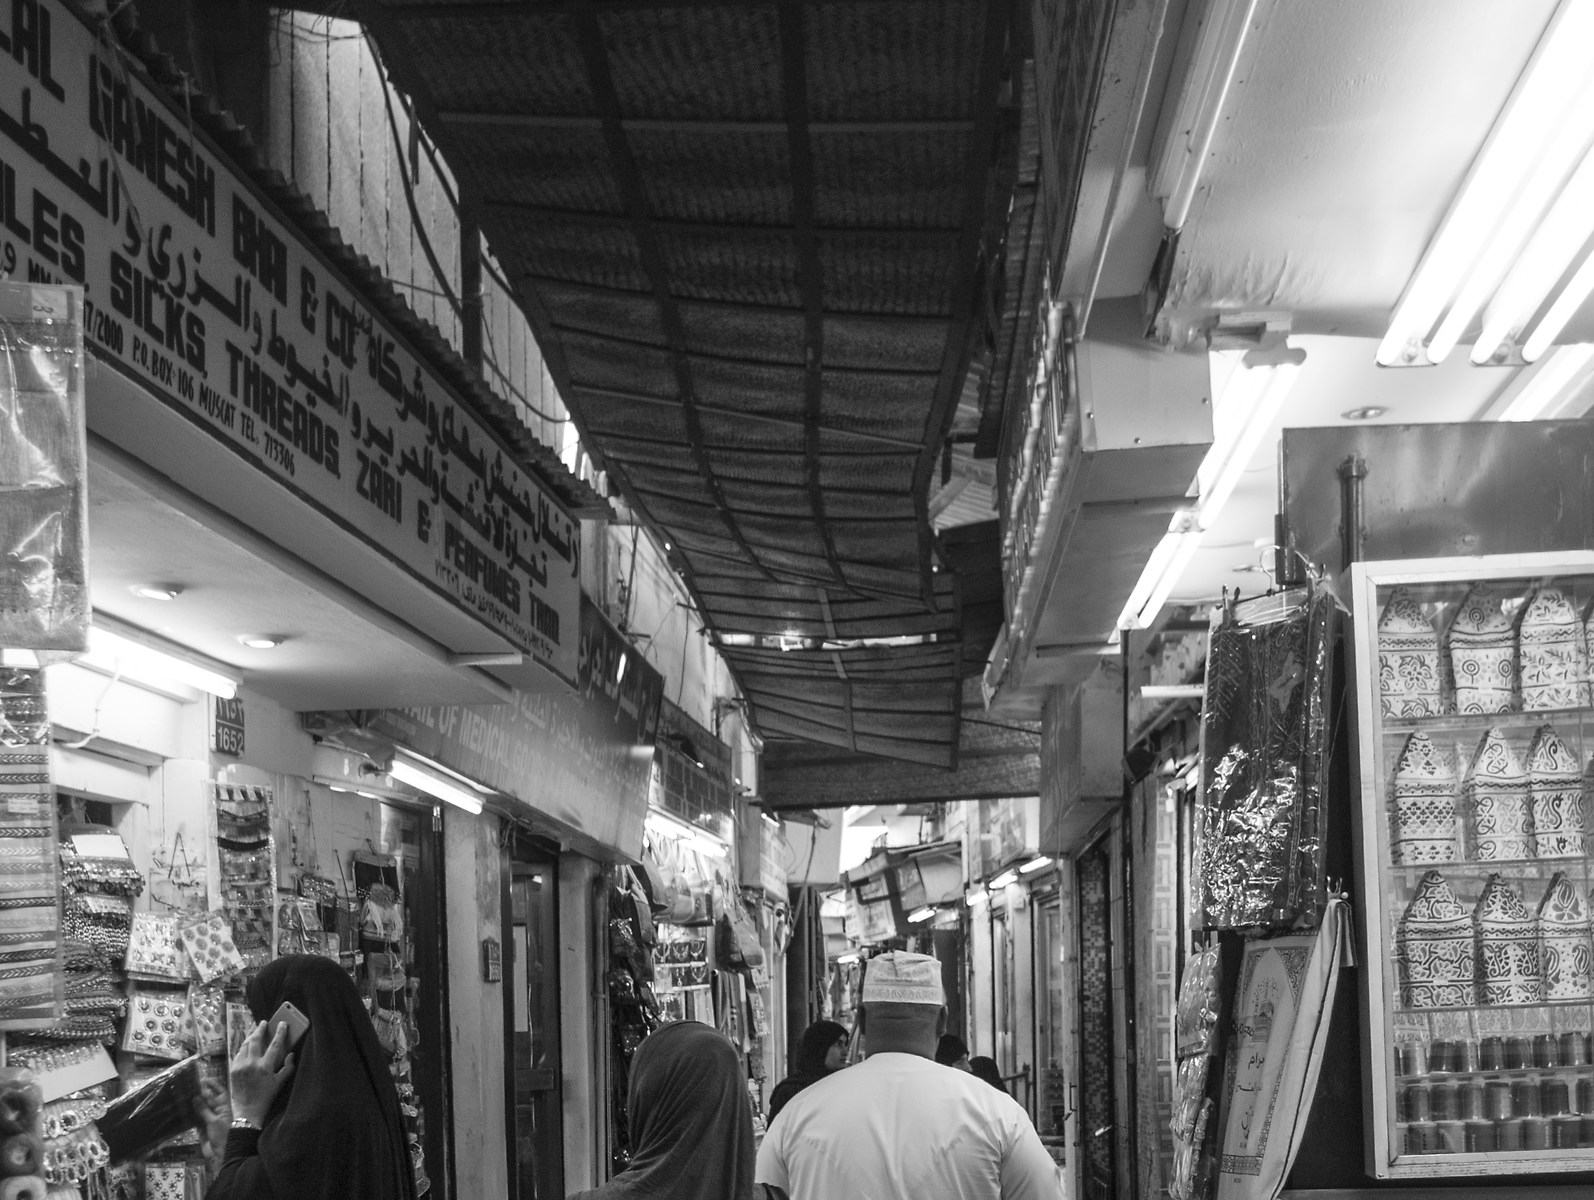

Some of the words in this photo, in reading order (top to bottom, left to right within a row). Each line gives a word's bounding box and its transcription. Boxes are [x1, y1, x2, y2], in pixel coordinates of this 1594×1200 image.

[90, 53, 215, 238] GANESH
[178, 367, 194, 402] 106
[200, 382, 236, 430] MUSCAT
[264, 430, 295, 477] 713306
[356, 448, 402, 525] ZARI
[445, 520, 521, 615] PERFUMES
[218, 727, 244, 756] 1652
[458, 706, 510, 768] MEDICAL
